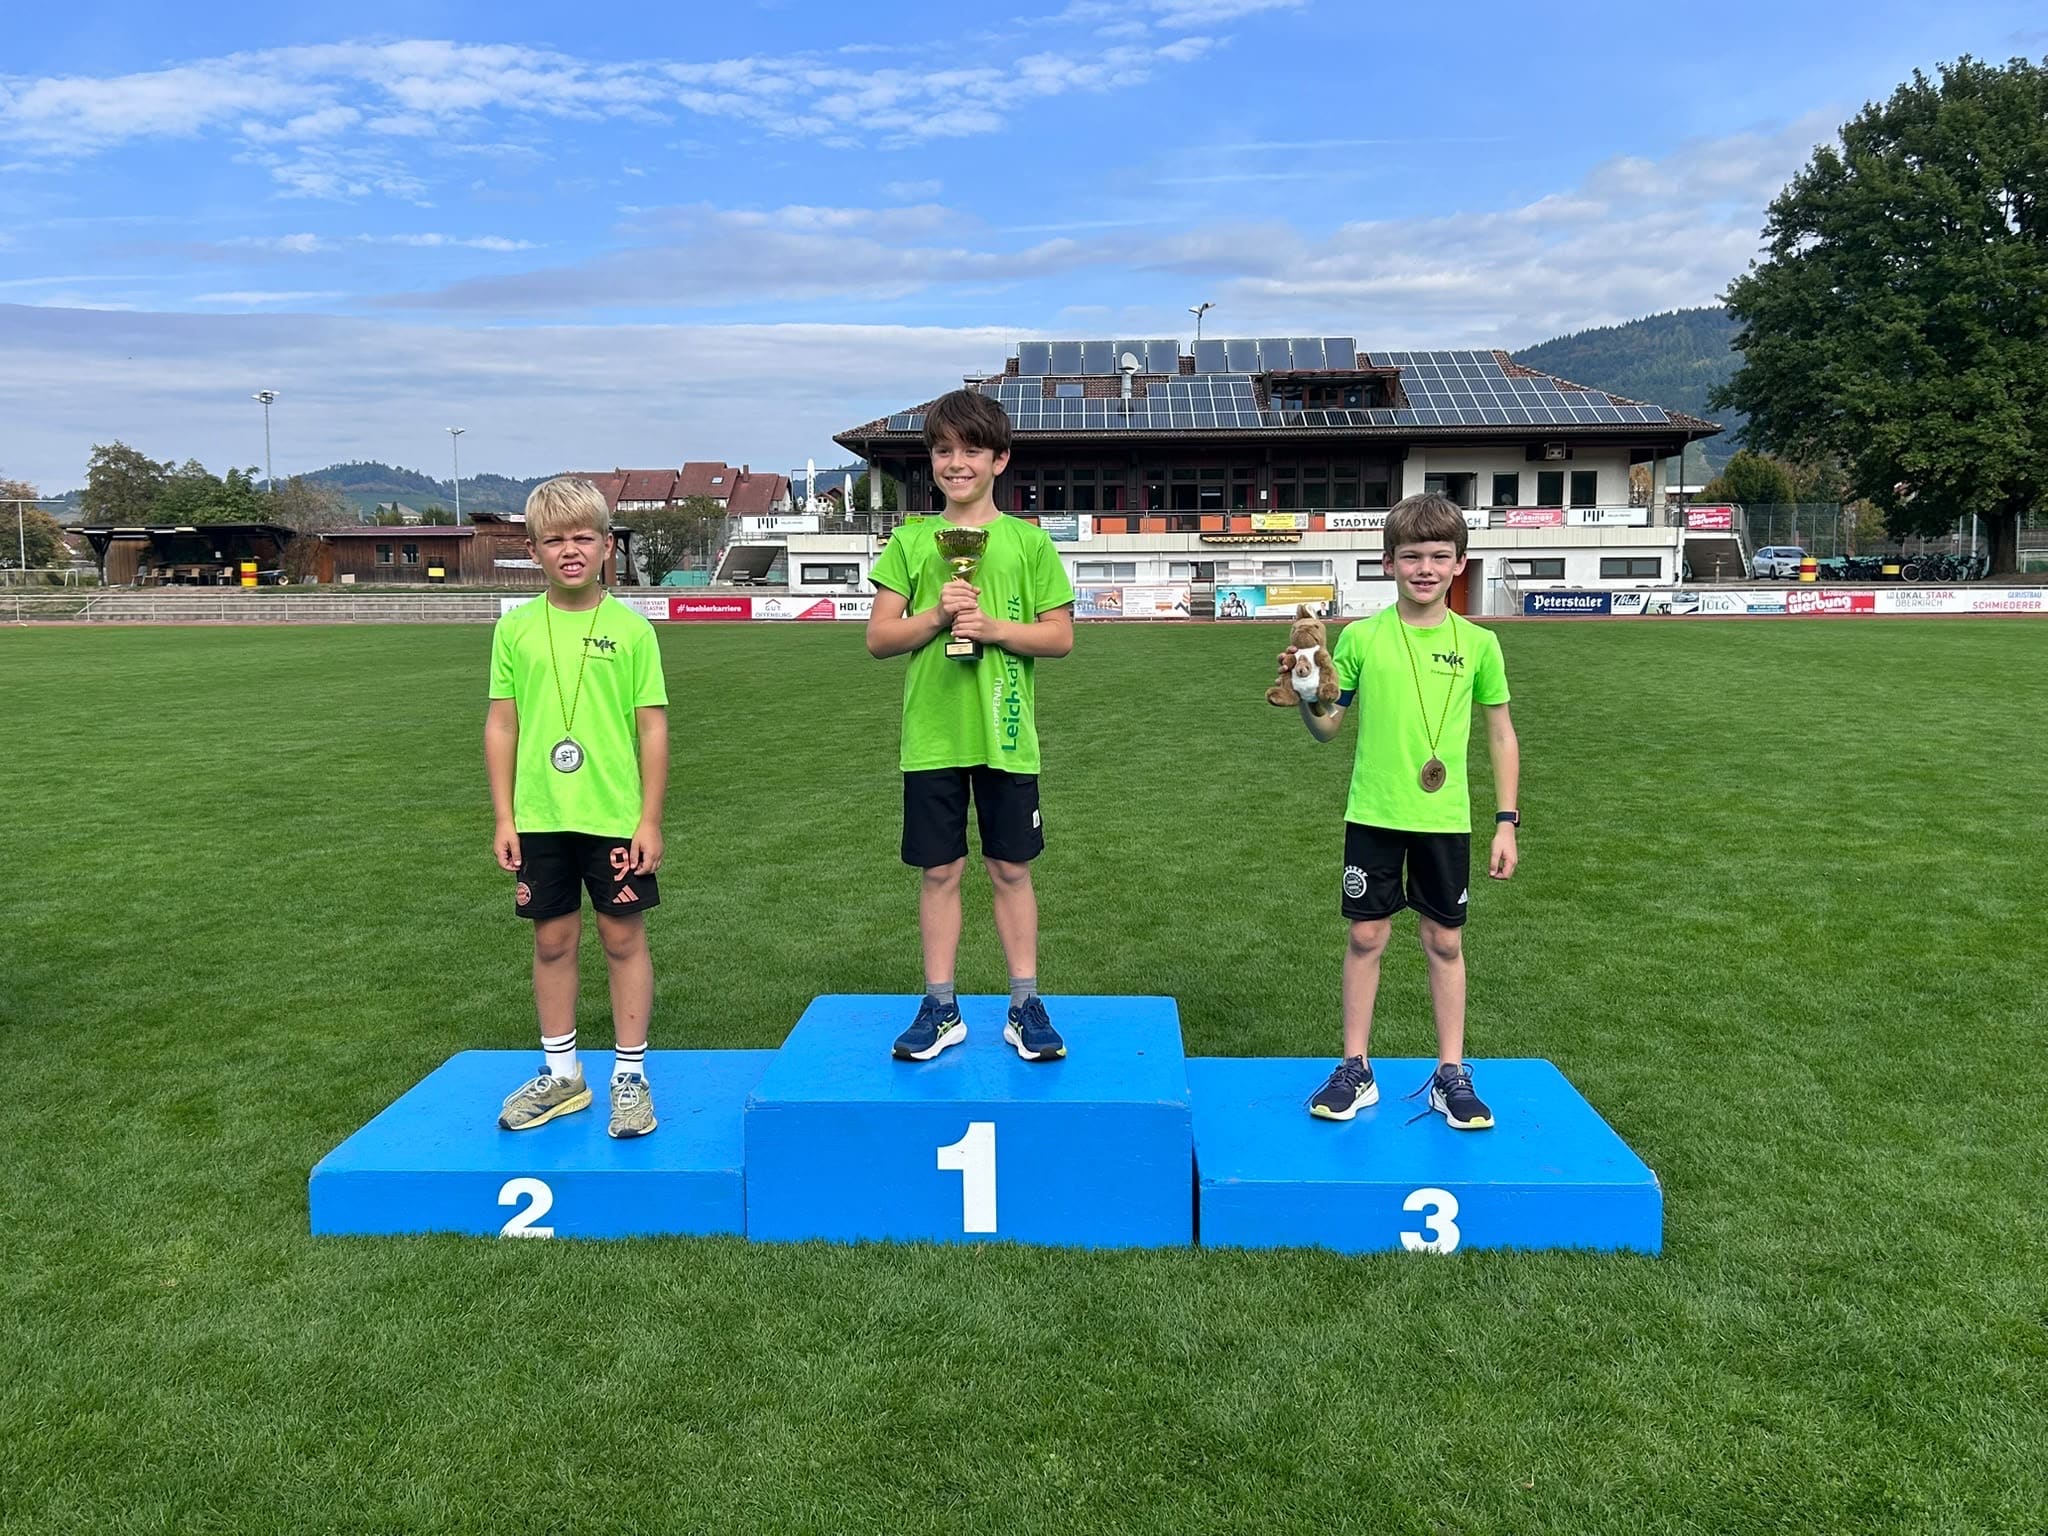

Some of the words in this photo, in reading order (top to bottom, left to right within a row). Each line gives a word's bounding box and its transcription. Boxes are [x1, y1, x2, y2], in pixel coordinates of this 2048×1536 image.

[1333, 518, 1385, 527] STADTWE
[1533, 594, 1603, 610] Peterstaler
[1788, 591, 1820, 604] elan
[1788, 596, 1852, 613] werbung
[1895, 599, 1943, 607] OBERKIRCH
[1972, 601, 2042, 609] SCHMIEDERER
[839, 603, 857, 611] HDI
[610, 846, 630, 882] 9
[937, 1121, 997, 1233] 1
[497, 1177, 555, 1239] 2
[1399, 1187, 1461, 1255] 3
